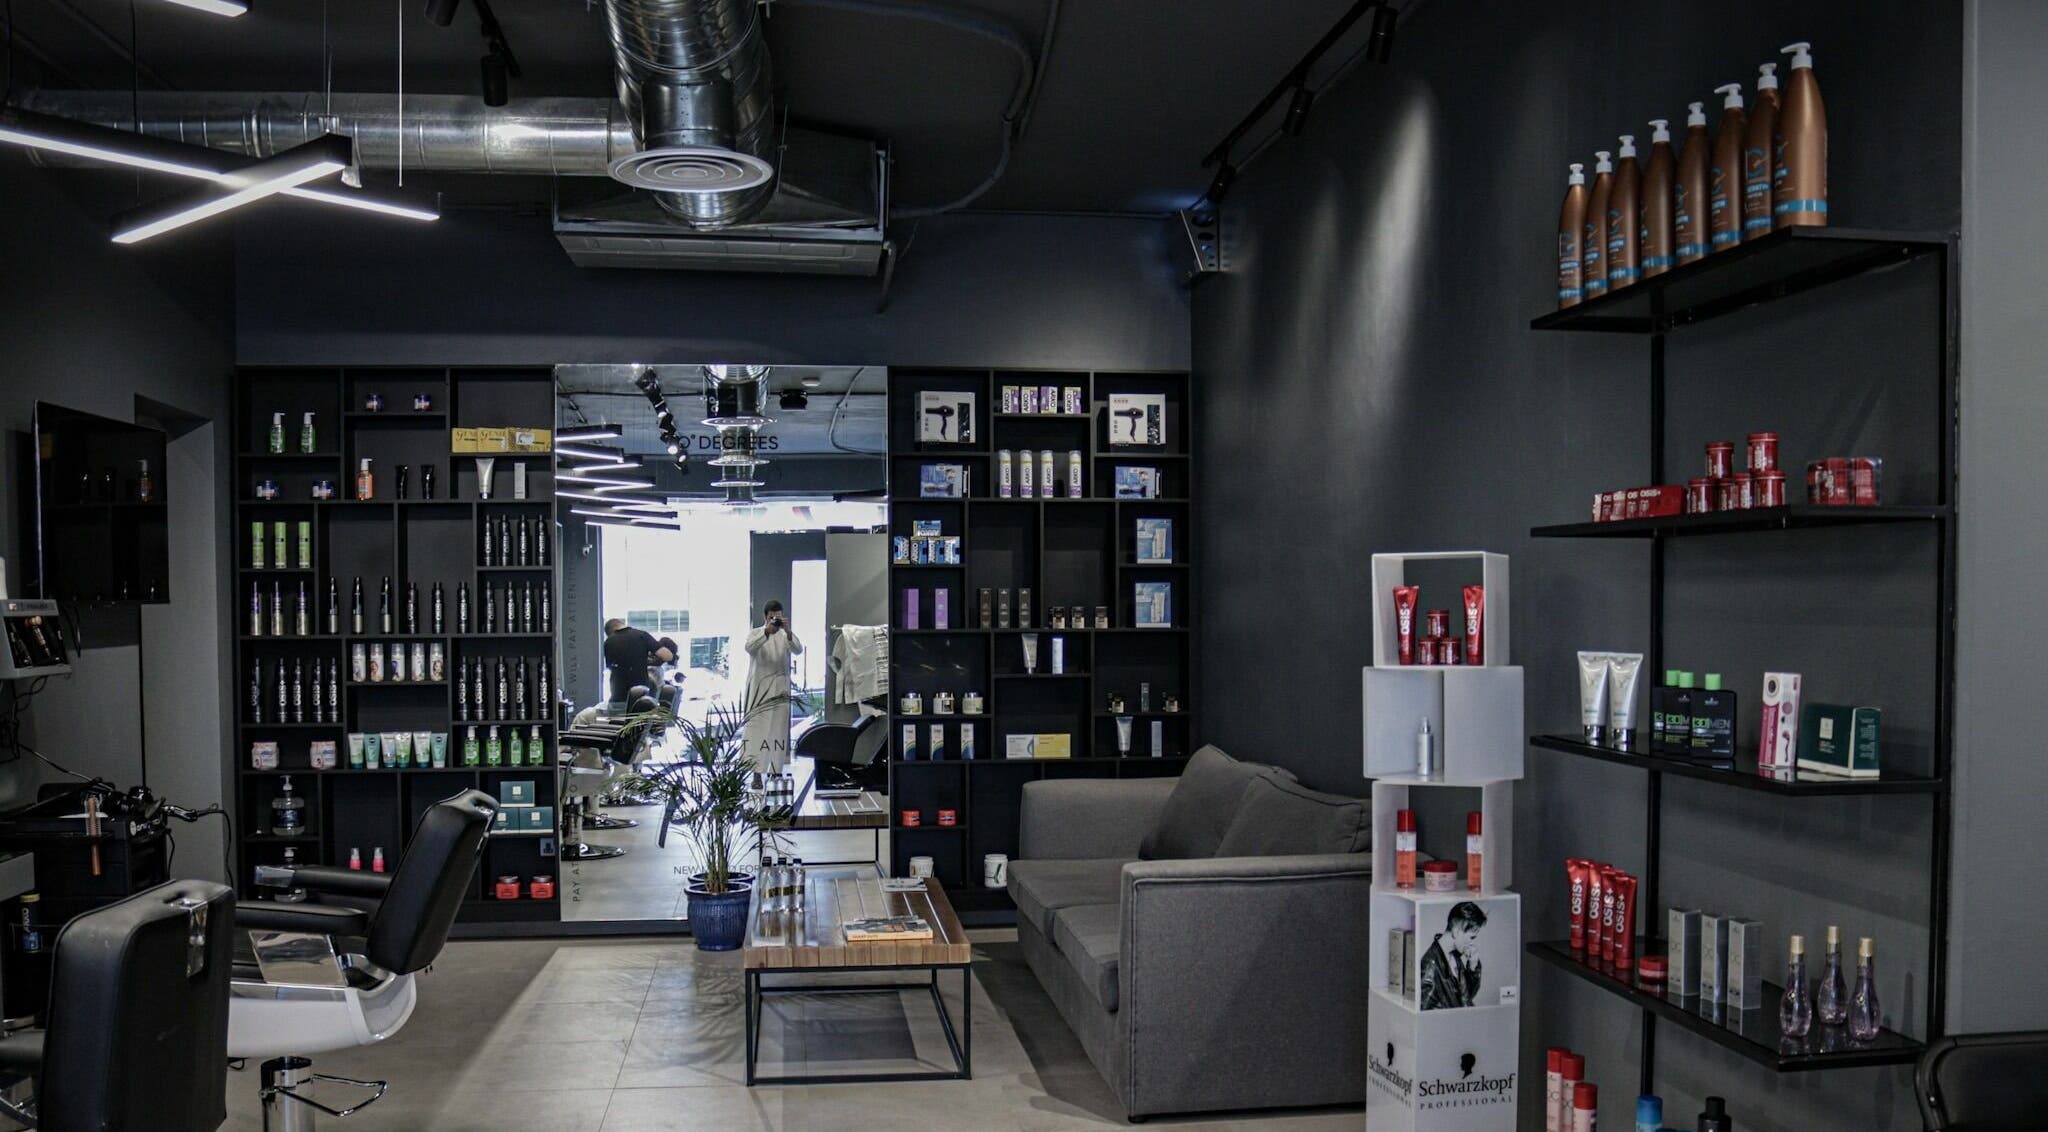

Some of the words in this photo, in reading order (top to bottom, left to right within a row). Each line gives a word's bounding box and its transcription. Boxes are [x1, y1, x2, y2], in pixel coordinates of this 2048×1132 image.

[699, 436, 779, 450] DEGREES
[674, 865, 700, 875] NEW
[1368, 1055, 1412, 1097] Schwarzkopf
[1419, 1073, 1516, 1097] Schwarzkopf
[1420, 1095, 1512, 1111] PROFESSIONAL
